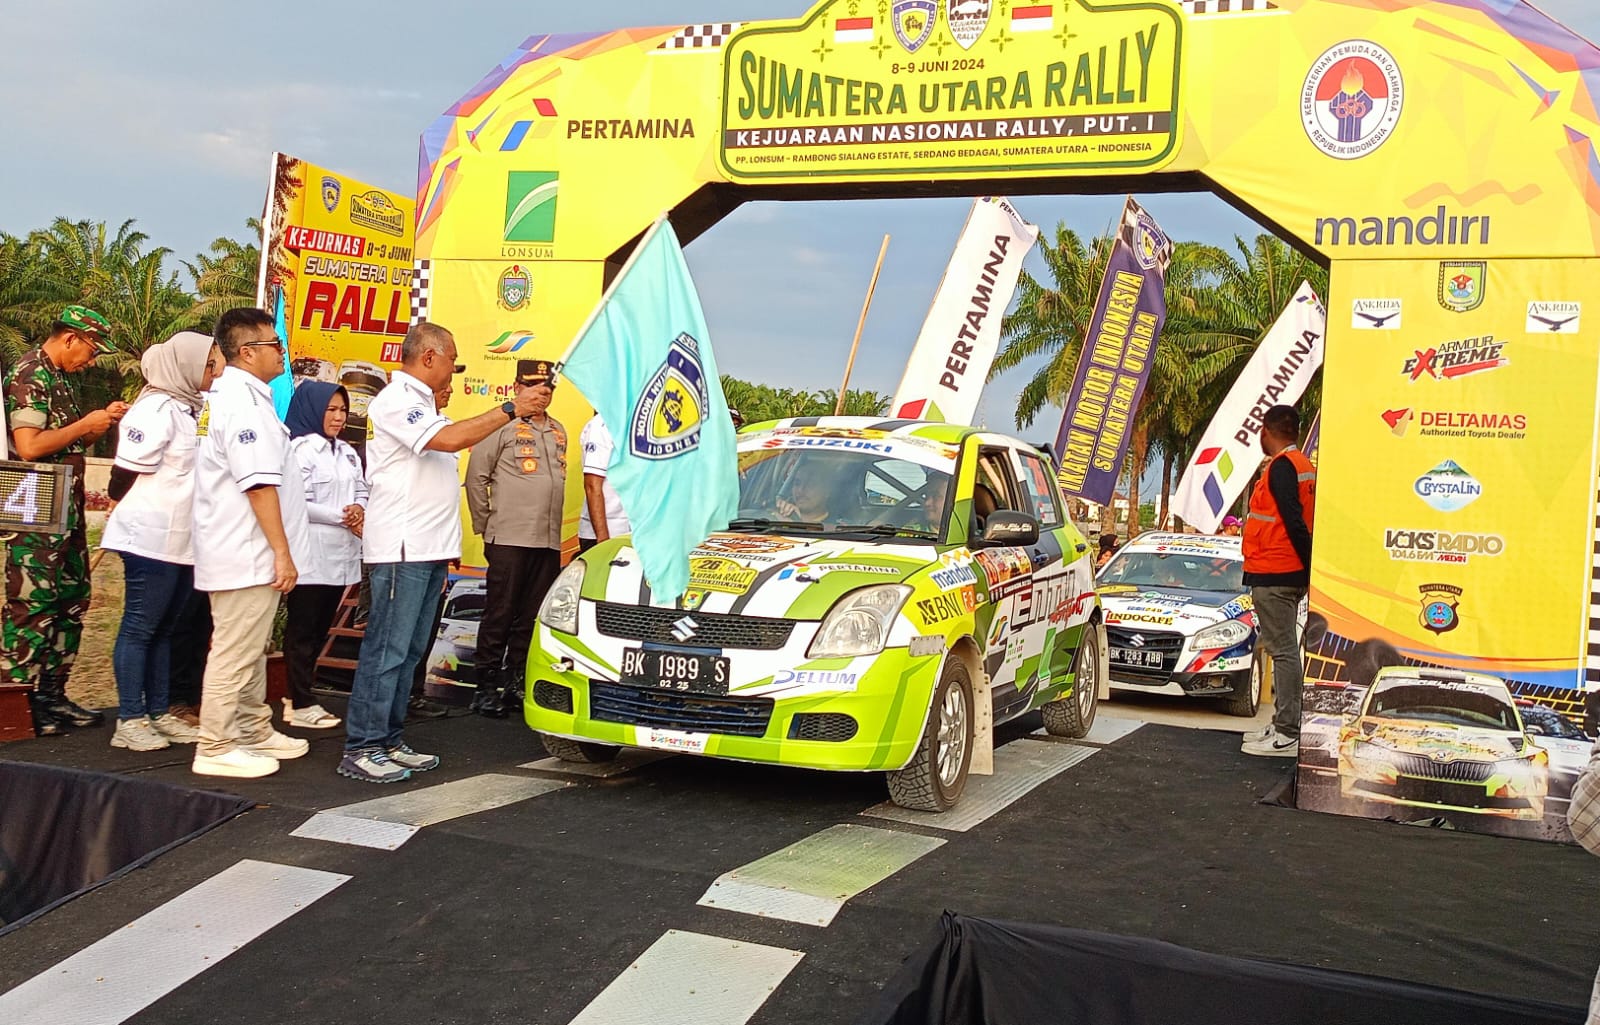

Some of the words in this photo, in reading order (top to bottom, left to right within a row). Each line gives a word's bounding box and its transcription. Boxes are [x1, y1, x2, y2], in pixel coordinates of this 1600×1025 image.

[738, 50, 907, 120] SUMATERA
[919, 71, 1033, 114] UTARA
[1046, 23, 1159, 106] RALLY
[891, 61, 915, 75] 8-9
[918, 60, 949, 73] JUNI
[952, 58, 985, 71] 2024
[1304, 55, 1332, 116] KEMENTERIAN
[1332, 45, 1370, 58] PEMUDA
[1371, 50, 1388, 65] DAN
[1386, 64, 1400, 113] OLAHRAGA
[566, 117, 695, 139] PERTAMINA
[736, 126, 863, 146] KEJUARAAN
[871, 121, 986, 142] NASIONAL
[995, 118, 1074, 137] RALLY,
[1083, 115, 1137, 133] PUT.
[1147, 114, 1154, 131] I
[1312, 129, 1346, 154] REPUBLIK
[1346, 128, 1388, 154] INDONESIA
[750, 155, 785, 164] LONSUM
[792, 153, 837, 163] RAMBONG
[838, 152, 876, 161] SIALANG
[877, 151, 911, 160] ESTATE,
[913, 150, 956, 159] SERDANG
[958, 148, 1001, 158] BEDAGAI,
[1002, 146, 1054, 156] SUMATERA
[1055, 145, 1088, 154] UTARA
[1098, 142, 1152, 153] INDONESIA
[1314, 205, 1490, 246] mandiri
[289, 227, 361, 255] KEJURNAS
[388, 246, 411, 262] JUNI
[501, 246, 554, 258] LONSUM
[304, 256, 387, 284] SUMATERA
[300, 281, 413, 337] RALL
[939, 235, 1011, 392] PERTAMINA
[1090, 270, 1144, 369] INDONESIA
[1438, 335, 1494, 353] ARMOUR
[1401, 344, 1503, 381] EXTREME
[1071, 366, 1116, 432] MOTOR
[1093, 375, 1139, 473] SUMATERA
[1122, 311, 1159, 373] UTARA
[1234, 330, 1320, 447] PERTAMINA
[637, 397, 653, 437] MOTOR
[1420, 411, 1526, 430] DELTAMAS
[787, 439, 894, 453] SUZUKI
[1420, 428, 1466, 437] Authorized
[1468, 429, 1496, 439] Toyota
[1497, 430, 1526, 440] Dealer
[1058, 429, 1097, 494] IKATAN
[4, 473, 38, 523] 4
[1169, 547, 1220, 555] SUZUKI
[1391, 549, 1416, 560] 104.6
[1437, 533, 1503, 555] RADIO
[698, 559, 723, 570] 26
[699, 573, 724, 581] UTARA
[723, 571, 754, 583] RALLY
[819, 565, 900, 574] PERTAMINA
[931, 562, 977, 589] mandiri
[936, 593, 963, 621] BNI
[624, 652, 646, 675] BK
[659, 655, 699, 680] 1989
[714, 660, 725, 683] S
[1110, 648, 1121, 660] BK
[660, 679, 672, 688] 02
